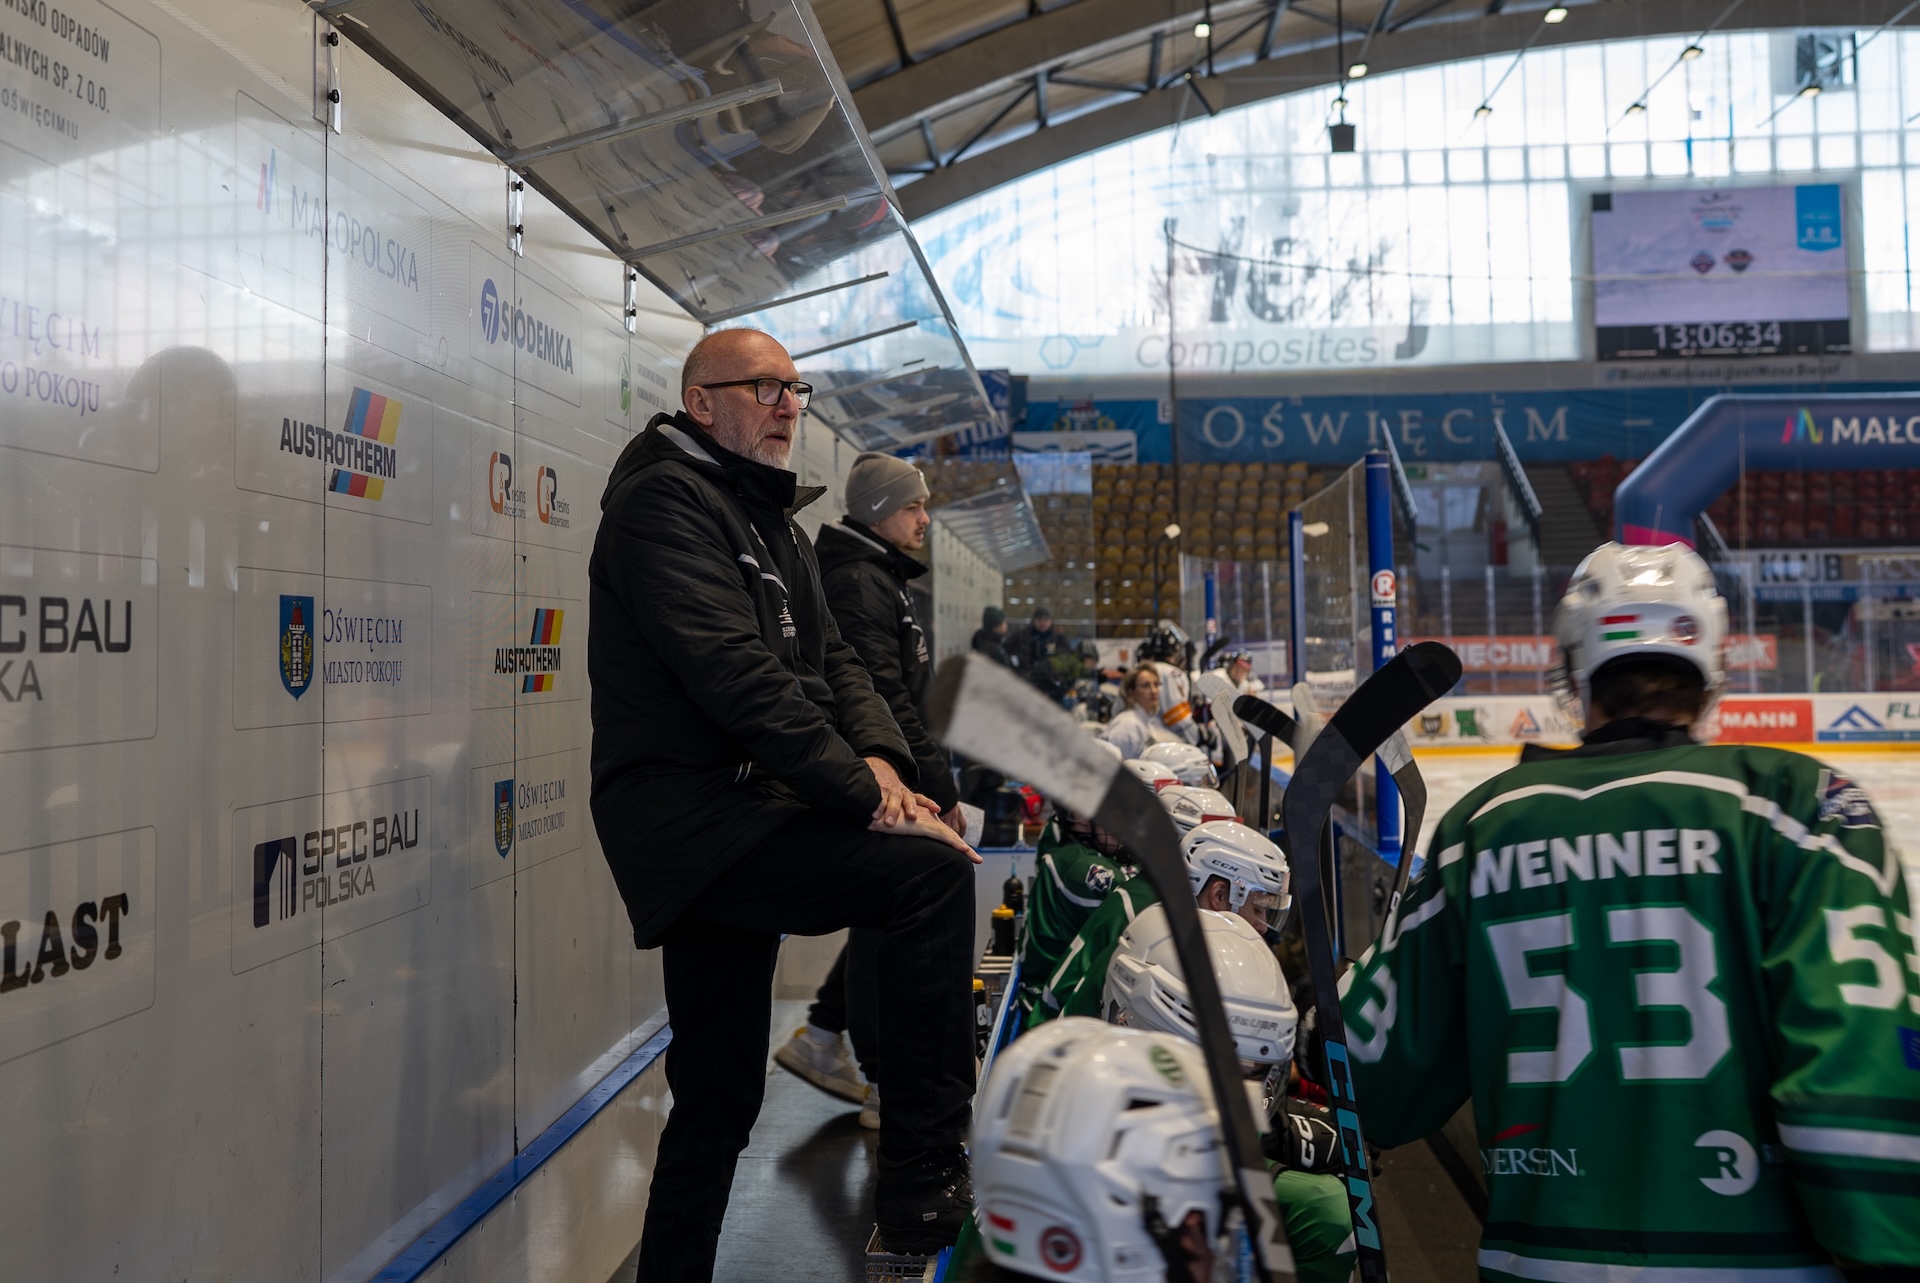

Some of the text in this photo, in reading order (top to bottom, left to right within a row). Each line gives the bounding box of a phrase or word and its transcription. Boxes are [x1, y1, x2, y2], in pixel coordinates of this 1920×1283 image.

[51, 8, 110, 63] ODPADÓW
[53, 61, 72, 94] SP.
[1, 87, 79, 140] OŚWIĘCIMIU
[291, 184, 419, 292] MAŁOPOLSKA
[501, 296, 574, 375] SIÓDEMKA
[1136, 331, 1378, 373] Composites
[1653, 322, 1782, 350] 13:06:34
[25, 366, 101, 417] POKOJU
[280, 417, 396, 479] AUSTROTHERM
[1203, 402, 1569, 457] OŚWIĘCIM
[39, 596, 132, 653] BAU
[323, 608, 402, 653] OŚWIĘCIM
[323, 660, 402, 686] MIASTO POKOJU
[494, 647, 561, 674] AUSTROTHERM
[1886, 702, 1920, 720] FL
[518, 779, 565, 810] OŚWIĘCIM
[302, 809, 418, 876] SPEC BAU
[518, 811, 565, 842] MIASTO POKOJU
[302, 864, 376, 913] POLSKA
[1211, 859, 1240, 872] CCM
[1470, 828, 1723, 899] WENNER
[1485, 906, 1733, 1084] 53
[1325, 1040, 1381, 1250] CCM
